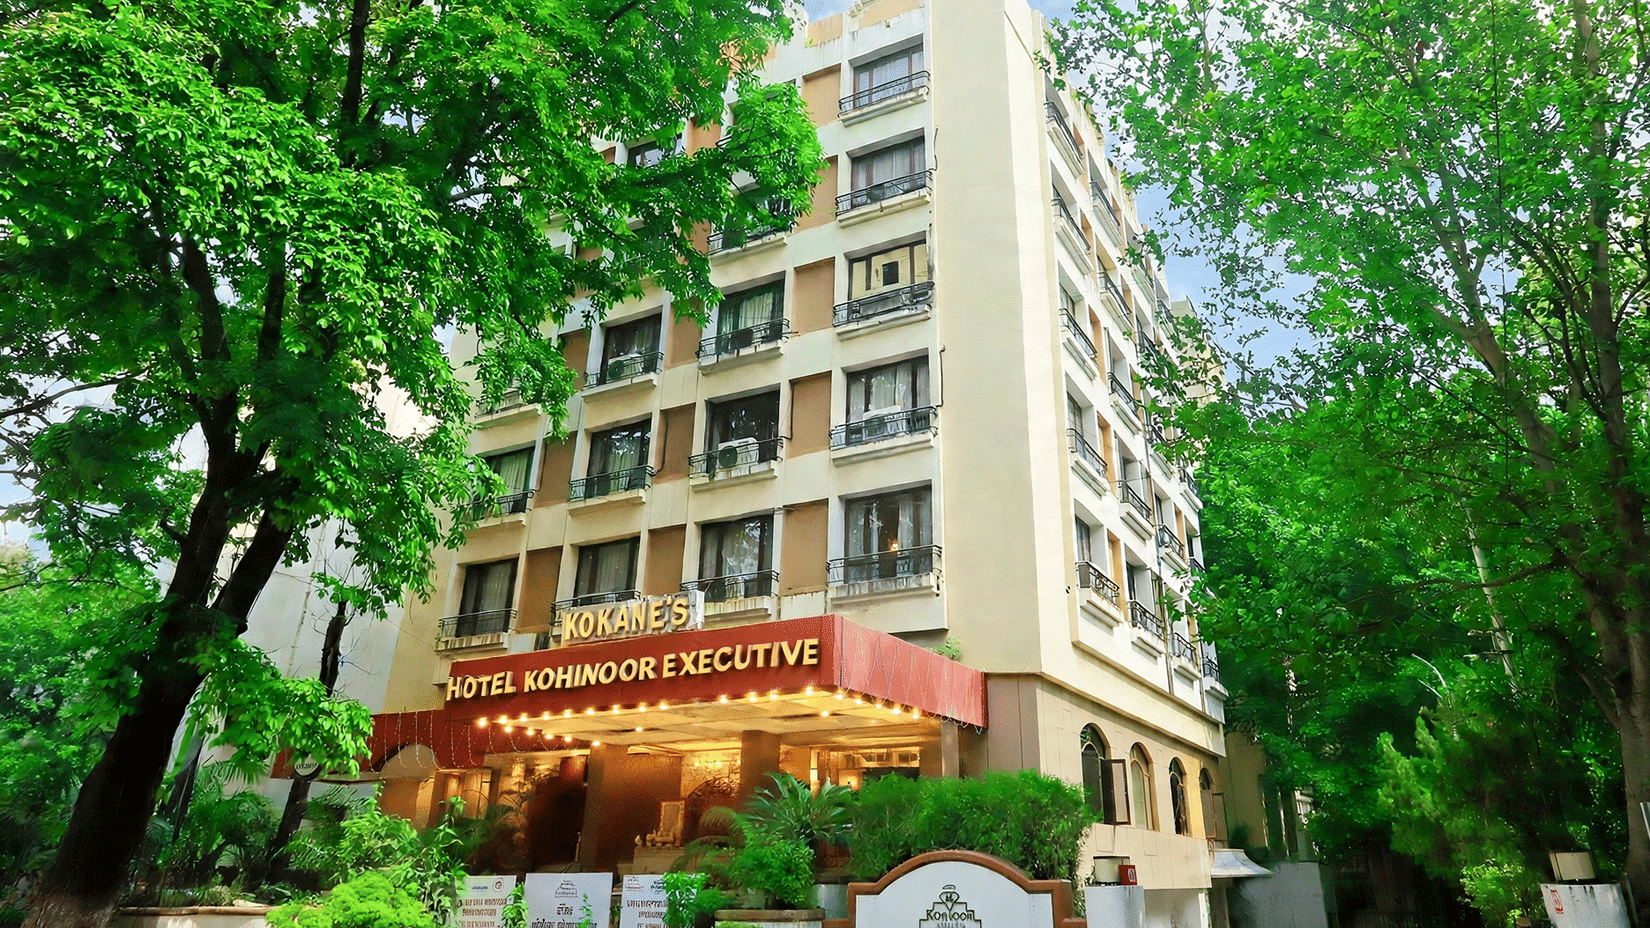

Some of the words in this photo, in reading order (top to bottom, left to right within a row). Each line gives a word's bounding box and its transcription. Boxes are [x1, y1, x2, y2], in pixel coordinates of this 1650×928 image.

[564, 596, 689, 640] KOKANE'S
[446, 671, 517, 701] HOTEL
[523, 656, 659, 693] KOHINOOR
[662, 638, 820, 678] EXECUTIVE
